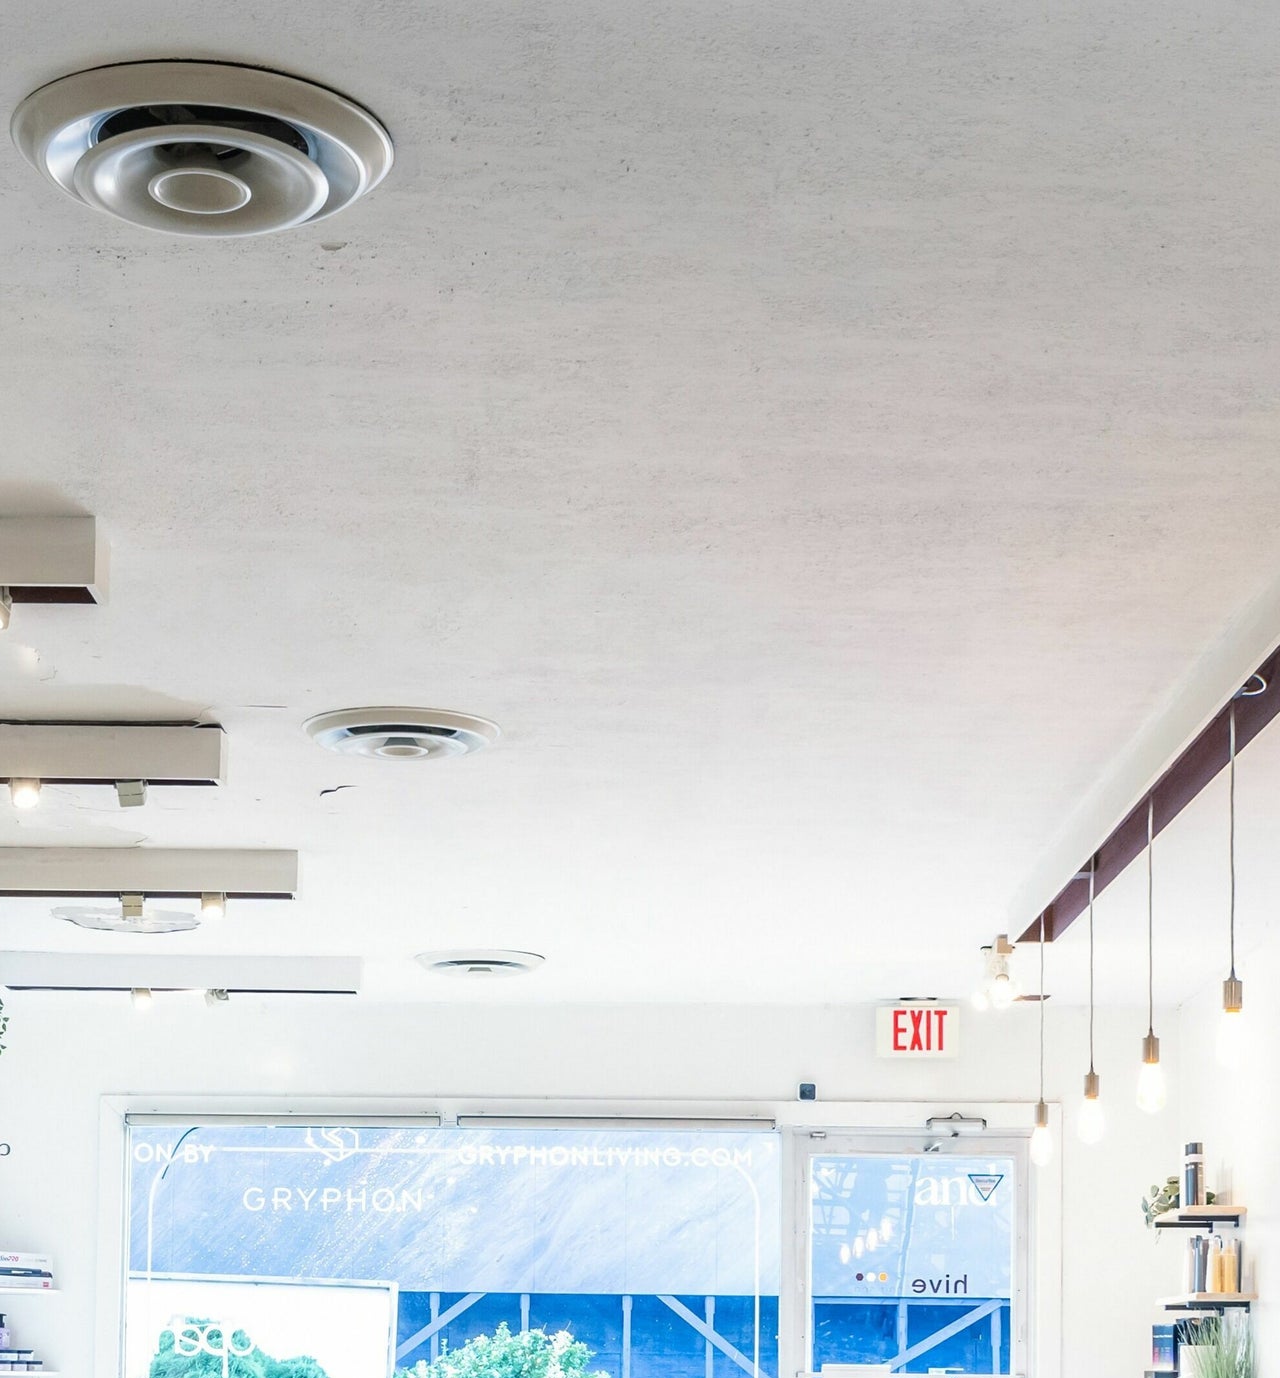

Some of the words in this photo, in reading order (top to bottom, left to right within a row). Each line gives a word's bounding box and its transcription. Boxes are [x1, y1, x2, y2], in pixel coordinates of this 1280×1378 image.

[892, 1009, 948, 1051] EXIT
[183, 1143, 215, 1164] BY
[457, 1144, 753, 1168] GRYPHONLIVING.COM
[242, 1186, 423, 1212] GRYPHON
